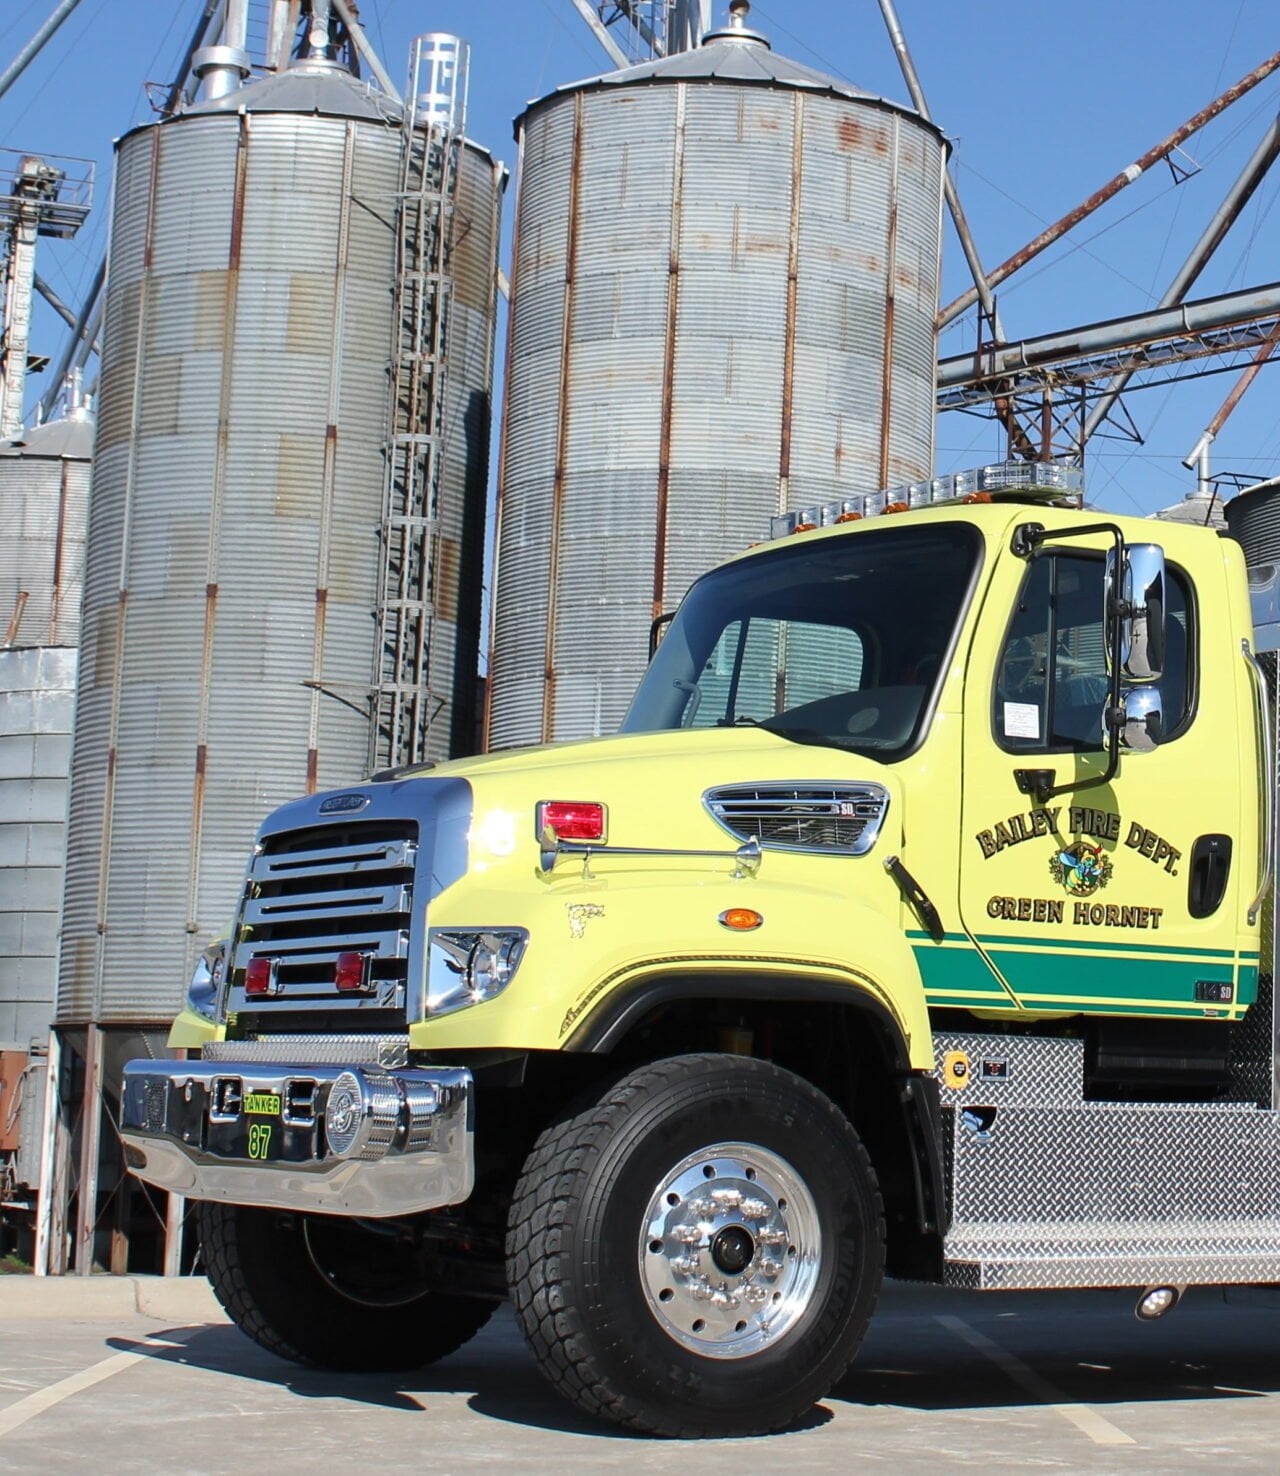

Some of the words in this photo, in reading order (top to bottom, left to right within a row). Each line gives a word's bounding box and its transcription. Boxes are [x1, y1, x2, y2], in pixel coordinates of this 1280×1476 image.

[976, 806, 1062, 860] BAILEY
[1069, 806, 1121, 841] FIRE
[1125, 821, 1182, 877] DEPT.
[986, 895, 1064, 924] GREEN
[1073, 902, 1163, 930] HORNET
[244, 1094, 280, 1115] TANKER
[248, 1124, 272, 1160] 87
